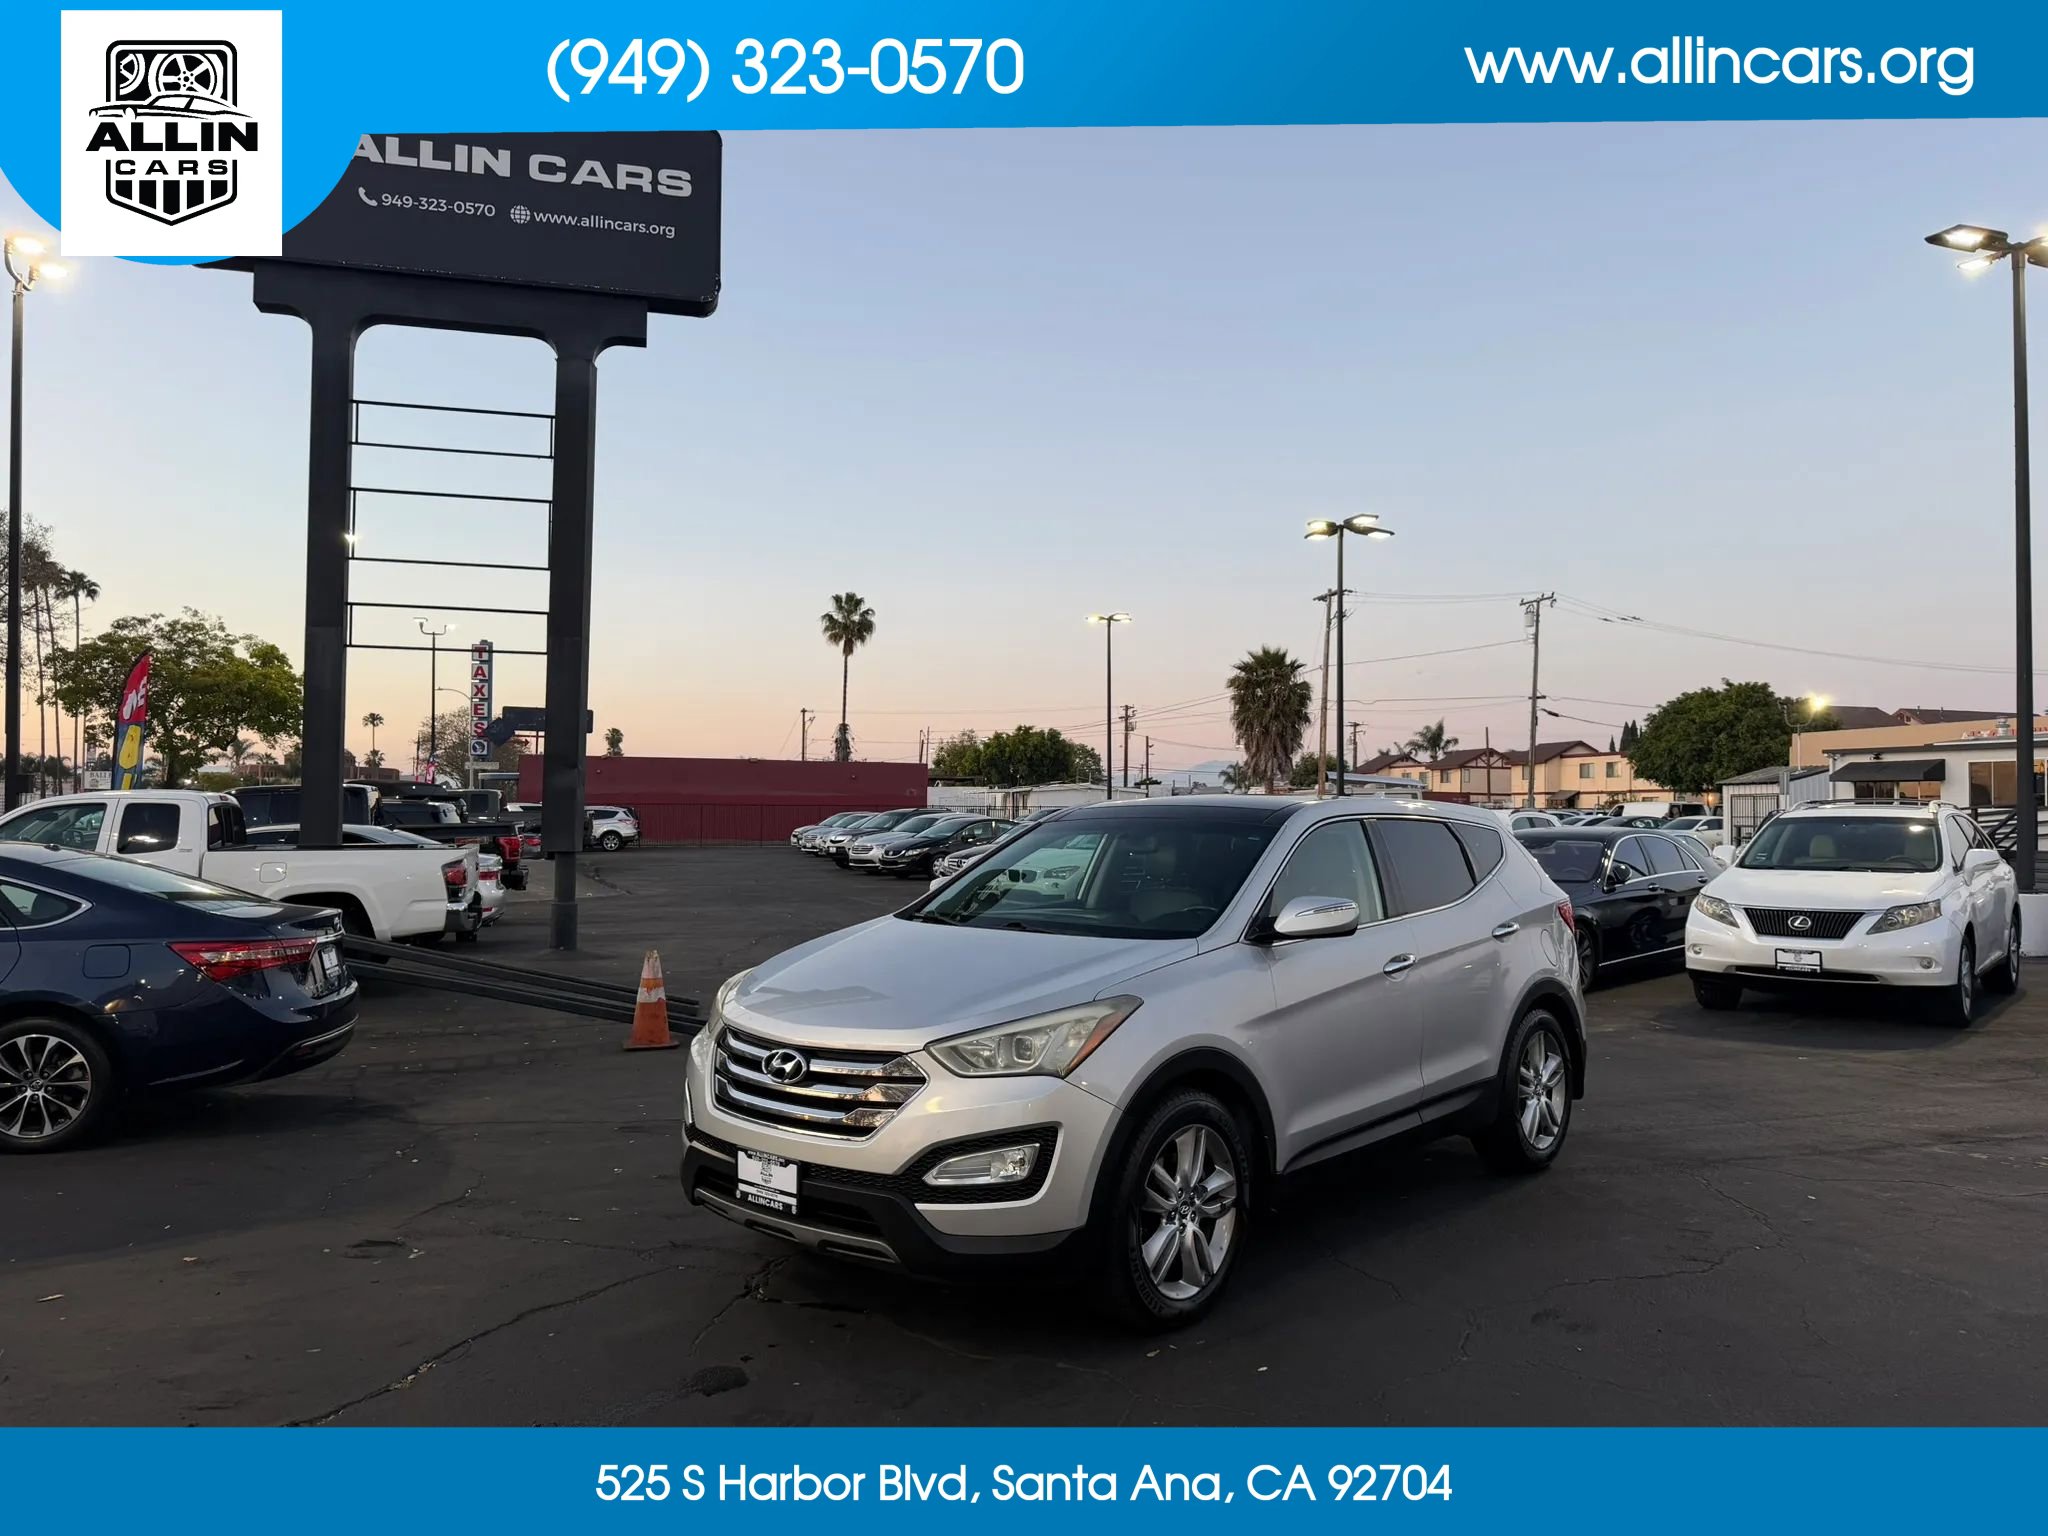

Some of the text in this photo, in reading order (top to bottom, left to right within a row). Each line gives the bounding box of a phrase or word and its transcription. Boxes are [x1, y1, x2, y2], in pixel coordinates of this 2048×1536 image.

[352, 133, 693, 197] ALLIN CARS
[381, 192, 496, 217] 949-323-0570
[534, 210, 676, 239] www.allincars.org
[473, 646, 487, 737] TAXES
[747, 1194, 783, 1211] ALLINCARS
